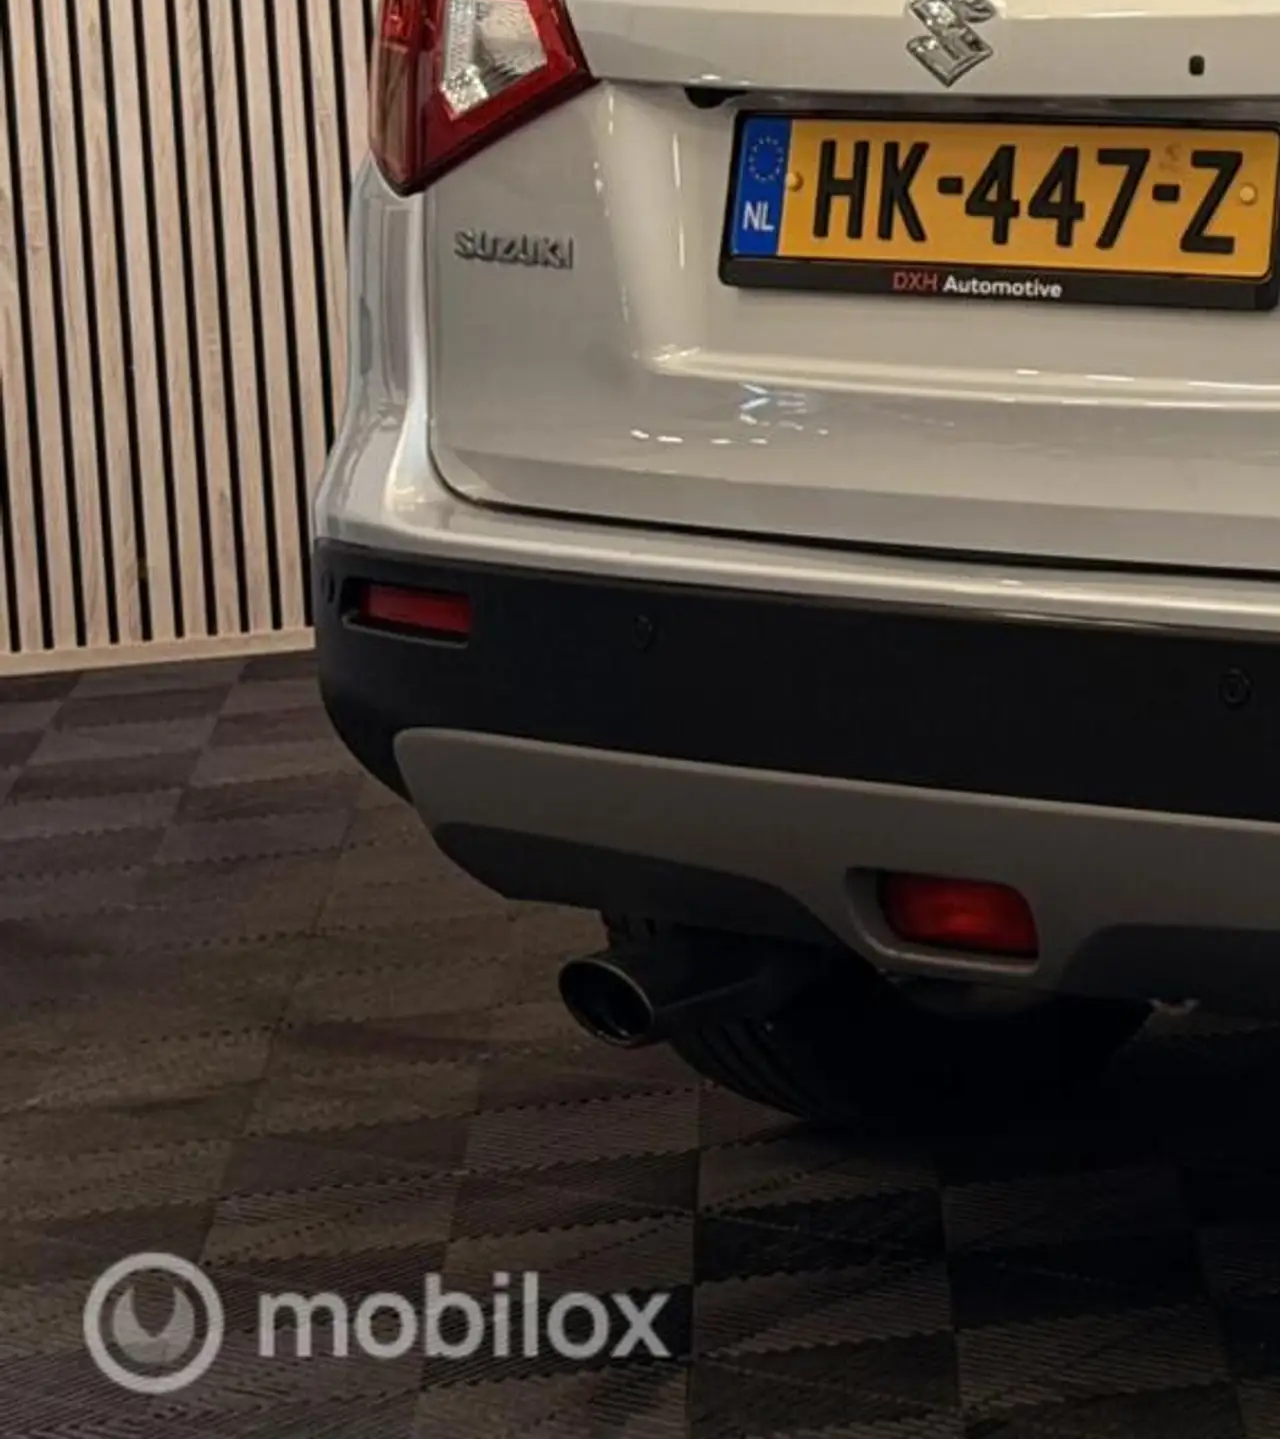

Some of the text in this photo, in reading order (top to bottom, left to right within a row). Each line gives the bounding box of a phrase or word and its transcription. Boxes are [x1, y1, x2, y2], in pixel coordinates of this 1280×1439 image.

[812, 139, 1244, 255] HK-447-Z
[742, 201, 774, 231] NL
[453, 230, 573, 269] SUZUKI
[892, 271, 1062, 298] DXH Automotive
